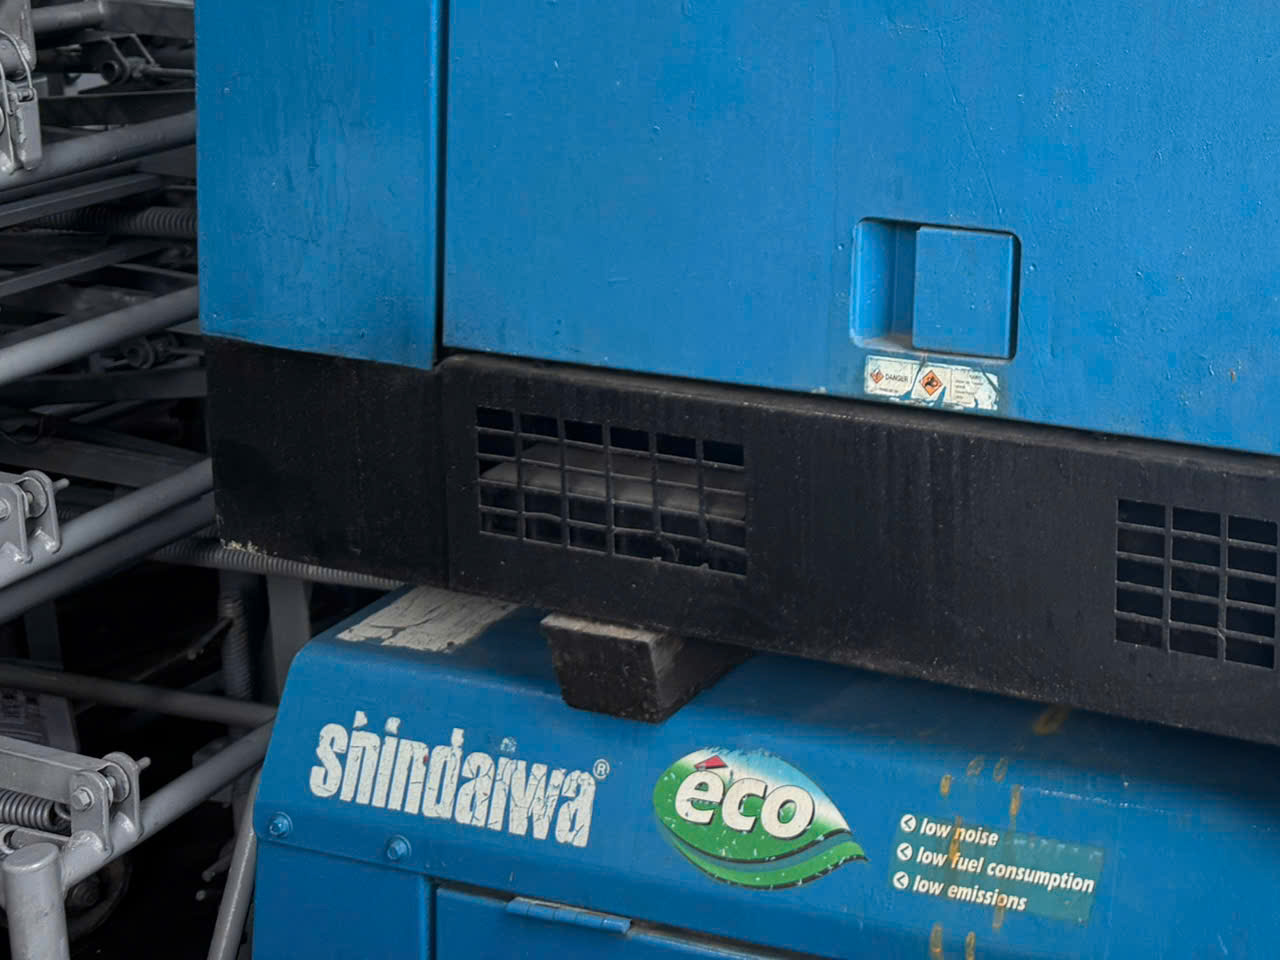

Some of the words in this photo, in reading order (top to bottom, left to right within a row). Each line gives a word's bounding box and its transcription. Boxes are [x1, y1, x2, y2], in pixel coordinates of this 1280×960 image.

[919, 817, 952, 836] low
[953, 826, 999, 846] noise
[916, 846, 948, 866] low
[951, 853, 984, 874] fuel
[986, 861, 1096, 892] consumption
[912, 875, 944, 895] low
[947, 883, 1028, 911] emissions
